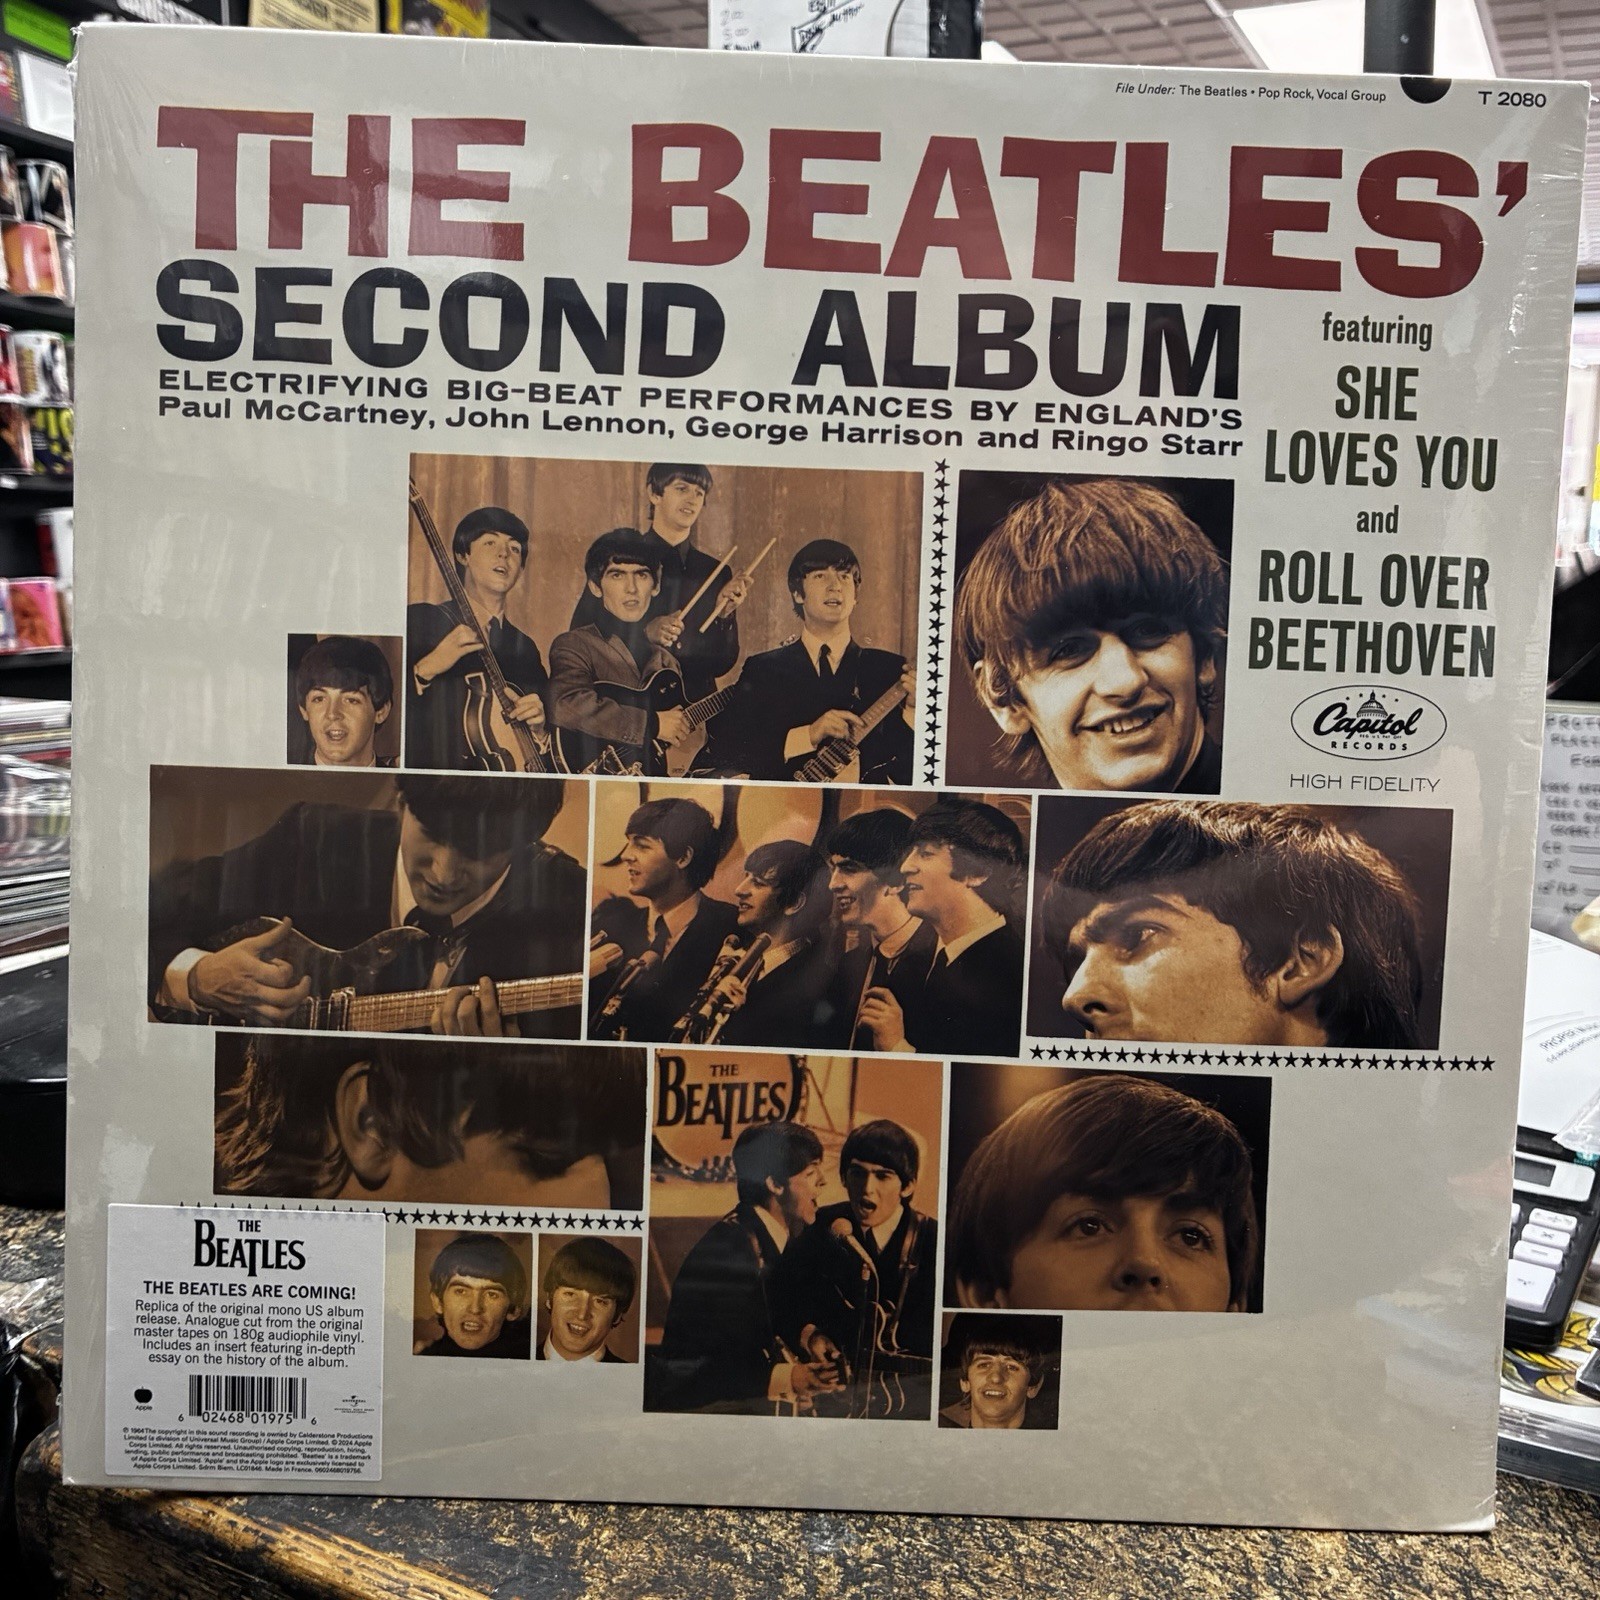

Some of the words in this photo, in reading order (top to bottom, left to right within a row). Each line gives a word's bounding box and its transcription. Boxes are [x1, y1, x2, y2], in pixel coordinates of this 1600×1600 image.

[1115, 82, 1135, 94] File
[1138, 83, 1176, 96] Under:
[1180, 85, 1201, 96] The
[1204, 86, 1248, 98] Beatles
[1258, 88, 1280, 100] Pop
[1283, 88, 1315, 101] Rock,
[1317, 90, 1348, 101] Vocal
[1351, 91, 1386, 103] Group
[1478, 92, 1493, 106] T
[1498, 93, 1547, 109] 2080
[157, 106, 527, 262] THE
[628, 122, 1530, 300] BEATLES'
[156, 258, 726, 378] SECOND
[791, 288, 1243, 400] ALBUM
[1322, 311, 1433, 352] featuring
[159, 368, 430, 399] ELECTRIFYING
[447, 379, 621, 406] BIG-BEAT
[640, 386, 952, 420] PERFORMANCES
[970, 400, 1017, 422] BY
[1035, 403, 1243, 430] ENGLAND'S
[1334, 364, 1419, 422] SHE
[158, 397, 232, 420] Paul
[244, 399, 437, 431] McCartney,
[446, 406, 531, 431] John
[541, 410, 677, 440] Lennon,
[684, 416, 809, 446] George
[820, 422, 964, 447] Harrison
[976, 429, 1040, 451] and
[1050, 430, 1150, 458] Ringo
[1160, 434, 1245, 458] Starr
[1264, 429, 1399, 488] LOVES
[1416, 435, 1499, 492] YOU
[1356, 504, 1400, 534] and
[1258, 550, 1364, 606] ROLL
[1380, 553, 1490, 611] OVER
[1248, 617, 1496, 679] BEETHOVEN
[1313, 702, 1424, 739] Capitol
[1331, 741, 1408, 751] RECORDS
[1289, 774, 1342, 789] HIGH
[1351, 776, 1441, 792] FIDELITY
[710, 1063, 739, 1076] THE
[657, 1055, 786, 1140] BEATLES
[237, 1219, 262, 1233] THE
[193, 1219, 306, 1277] BEATLES
[143, 1280, 174, 1295] THE
[179, 1282, 247, 1297] BEATLES
[251, 1284, 283, 1298] ARE
[287, 1285, 356, 1301] COMING!
[135, 1300, 179, 1313] Replica
[182, 1302, 195, 1313] of
[198, 1303, 217, 1313] the
[220, 1303, 264, 1316] original
[268, 1306, 301, 1316] mono
[305, 1305, 323, 1317] US
[327, 1306, 364, 1318] album
[136, 1313, 181, 1325] release.
[184, 1314, 240, 1328] Analogue
[243, 1317, 262, 1328] cut
[266, 1316, 293, 1328] from
[297, 1317, 316, 1329] the
[319, 1318, 363, 1332] original
[133, 1327, 174, 1338] master
[177, 1328, 209, 1341] tapes
[213, 1331, 228, 1339] on
[233, 1328, 265, 1343] 180g
[268, 1330, 330, 1344] audiophile
[333, 1332, 365, 1345] vinyl.
[143, 1338, 192, 1351] Includes
[195, 1342, 210, 1352] an
[214, 1341, 247, 1353] insert
[250, 1341, 303, 1357] featuring
[307, 1343, 356, 1358] in-depth
[148, 1354, 181, 1366] essay
[184, 1355, 200, 1364] on
[203, 1353, 223, 1365] the
[226, 1354, 267, 1368] history
[269, 1355, 282, 1367] of
[285, 1356, 304, 1367] the
[307, 1356, 349, 1368] album.
[178, 1413, 184, 1422] 6
[202, 1411, 244, 1423] 02468
[251, 1412, 293, 1425] 01975
[311, 1417, 317, 1425] 6
